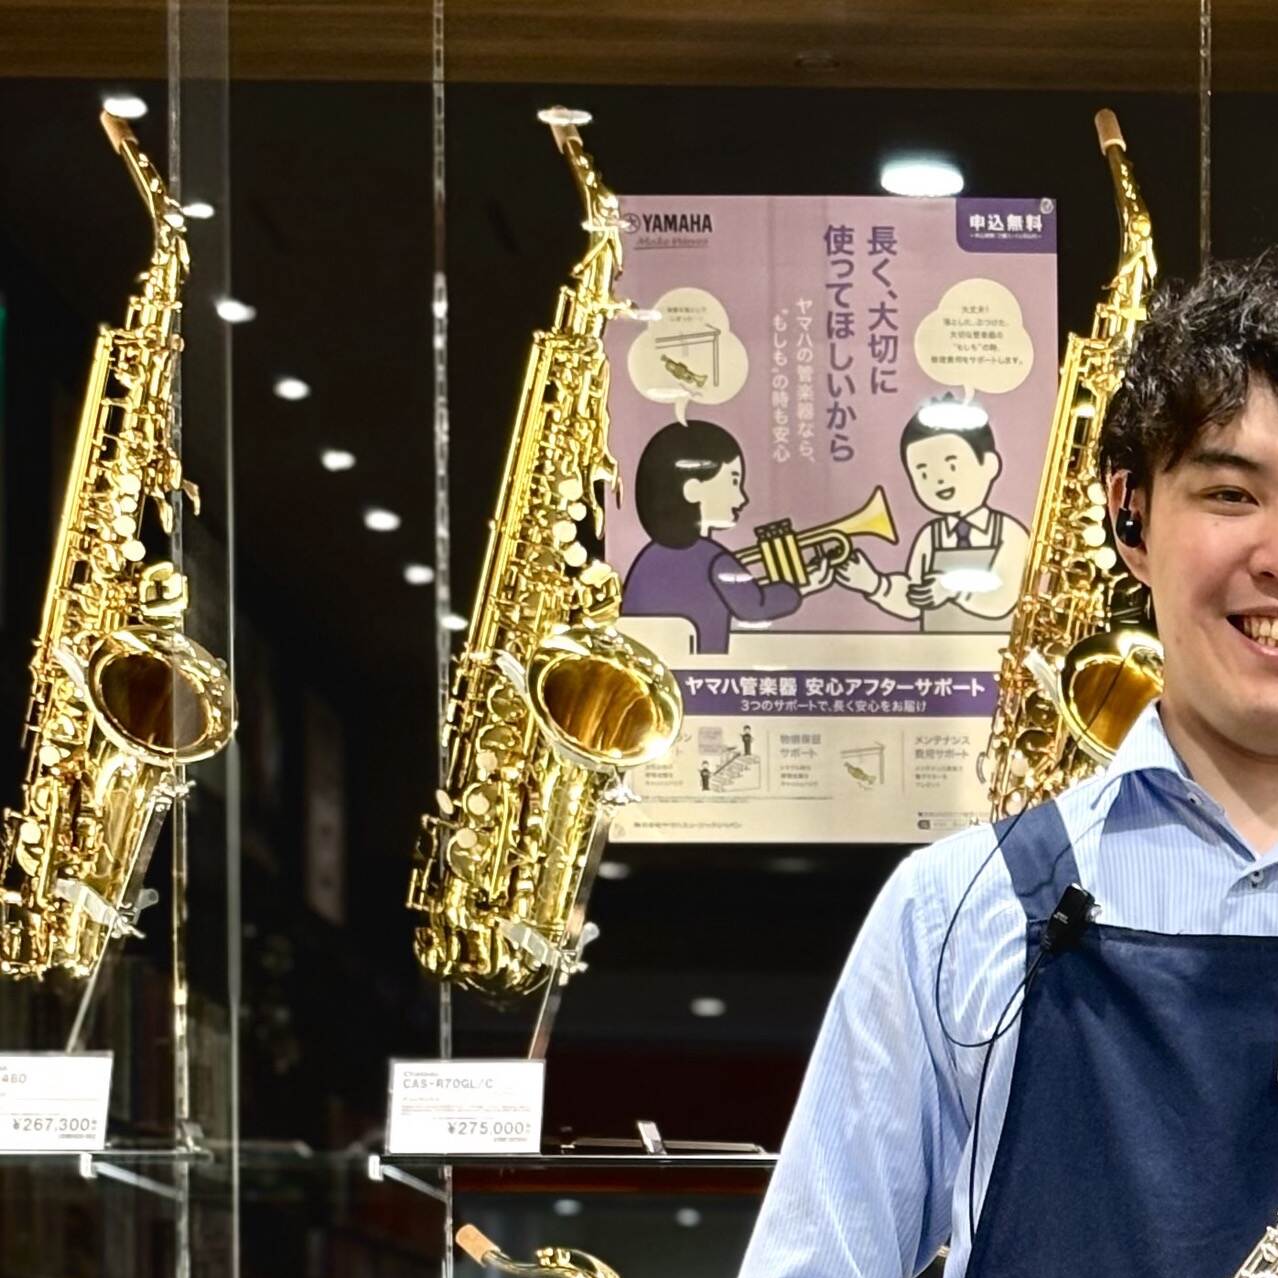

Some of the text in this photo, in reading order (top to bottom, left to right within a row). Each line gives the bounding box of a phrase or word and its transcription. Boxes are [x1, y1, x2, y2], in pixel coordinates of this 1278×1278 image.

[642, 213, 713, 233] YAMAHA
[969, 213, 1043, 232] 申込無料
[867, 226, 898, 395] 長く、大切に
[824, 225, 857, 463] 使ってほしいから
[685, 677, 985, 697] ヤマハ管楽器 安心アフターサポート
[915, 736, 970, 745] メンテナンス
[12, 1117, 91, 1132] ¥267,300
